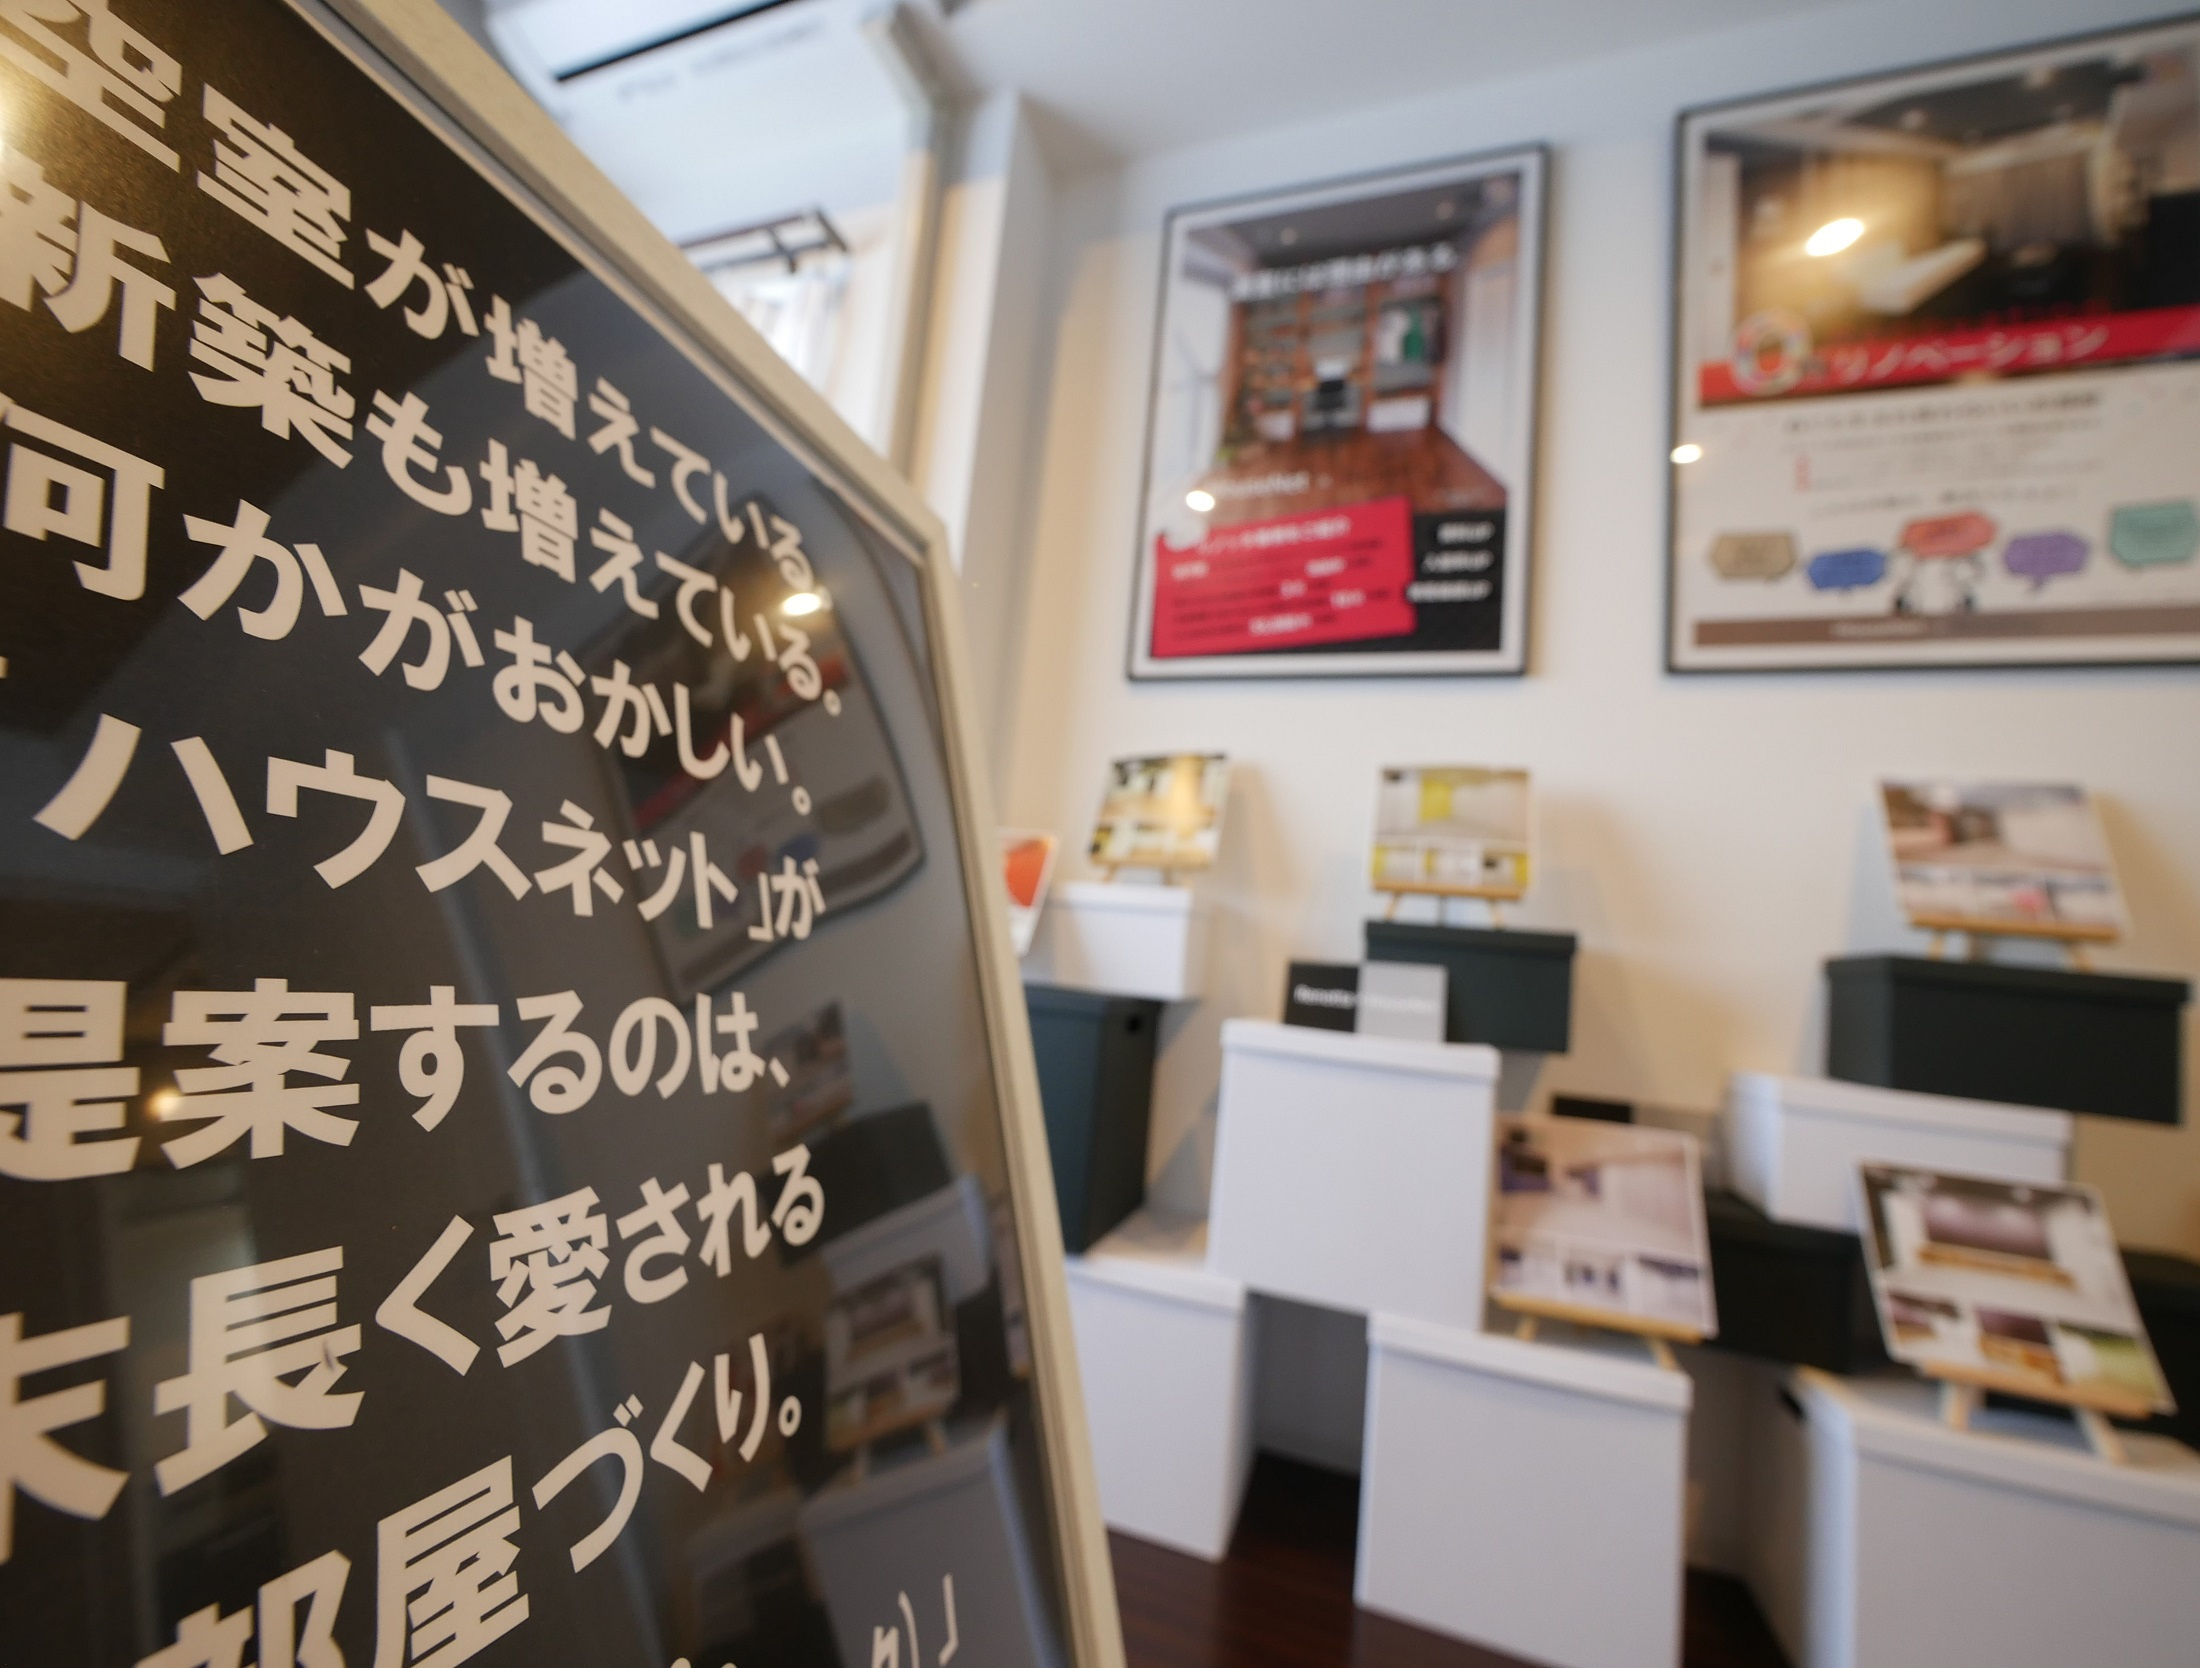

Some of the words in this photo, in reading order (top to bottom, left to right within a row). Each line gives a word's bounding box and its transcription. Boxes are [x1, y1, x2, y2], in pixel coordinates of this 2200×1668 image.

[0, 655, 826, 942] ハウスネット」が
